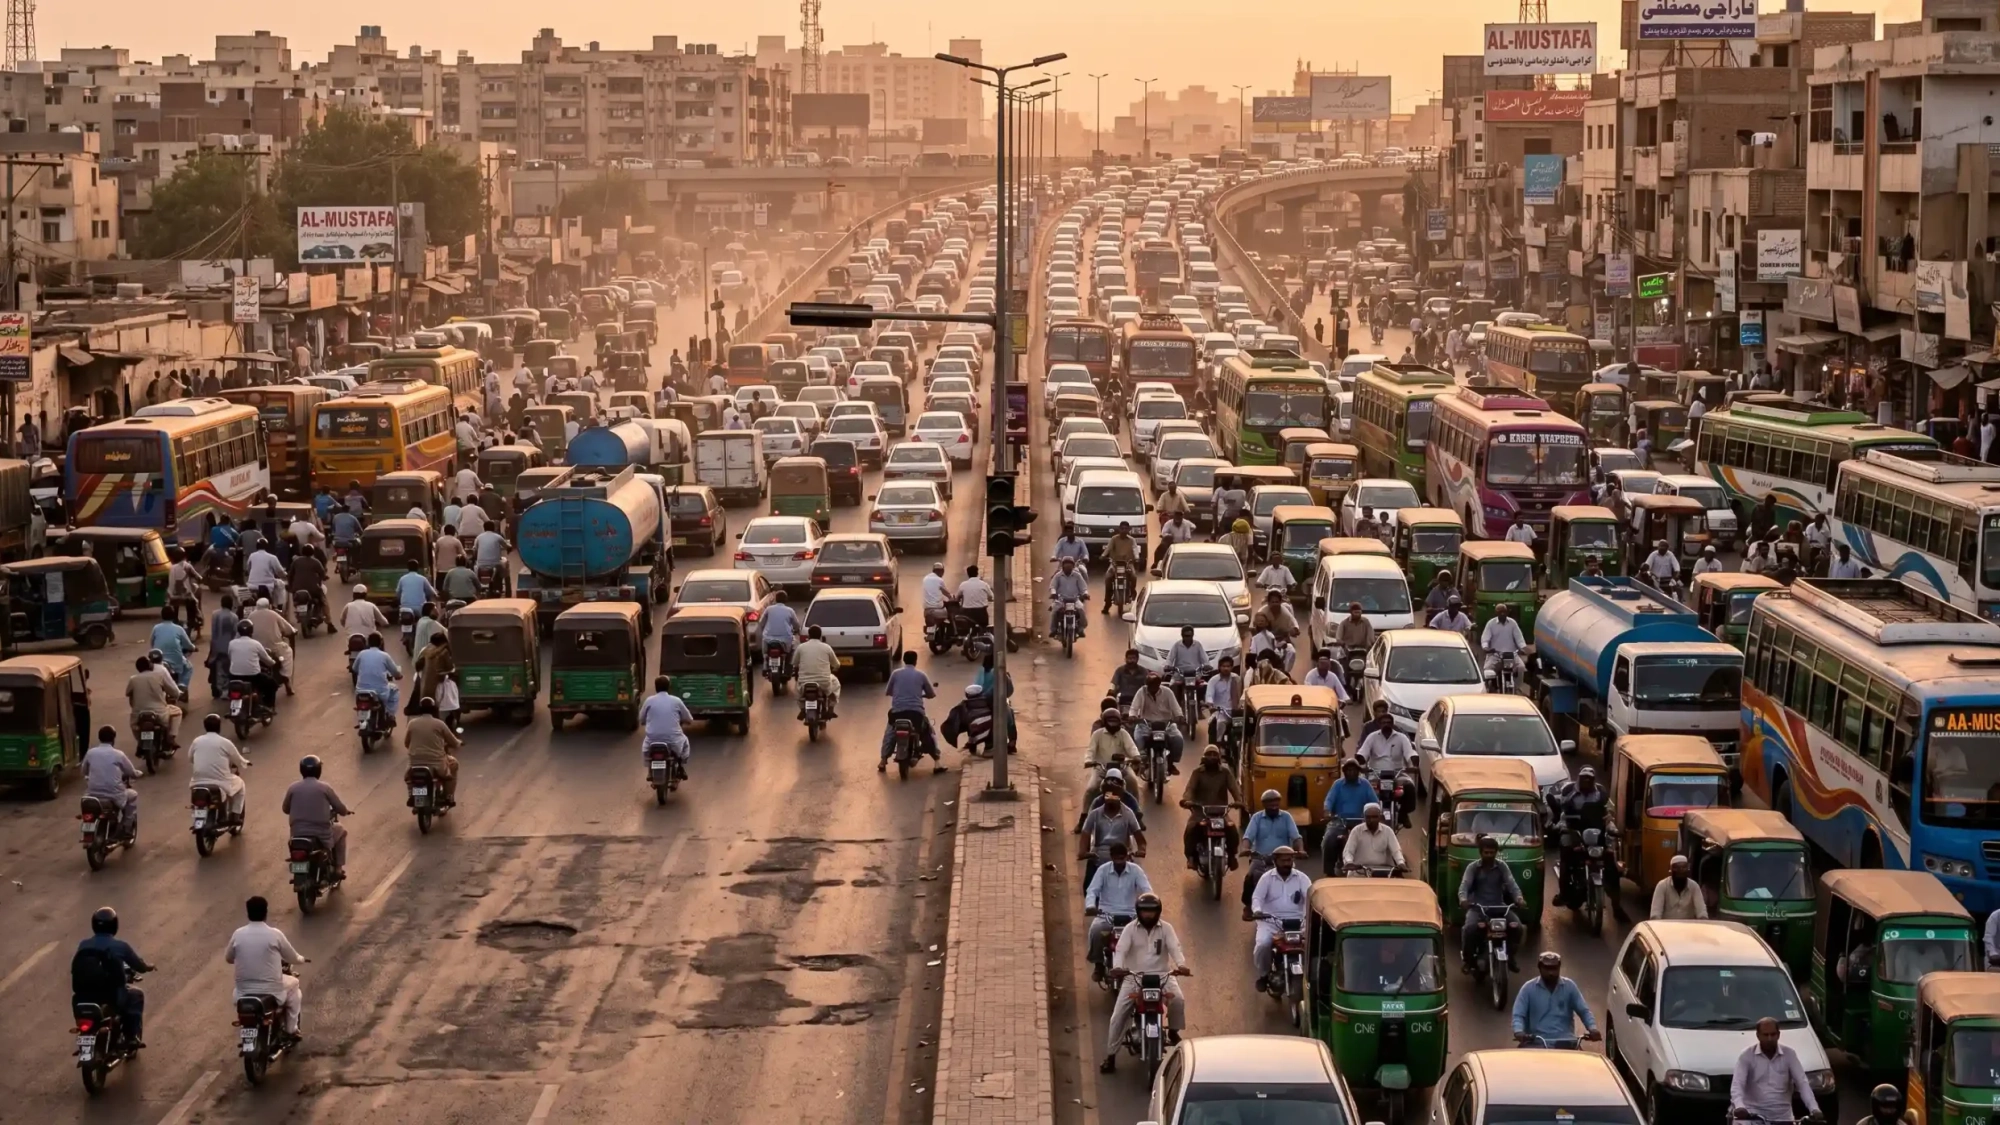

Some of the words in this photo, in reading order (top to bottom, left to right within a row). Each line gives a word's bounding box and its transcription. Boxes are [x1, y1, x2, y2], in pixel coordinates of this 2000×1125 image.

[1487, 29, 1592, 50] AL-MUSTAFA
[300, 211, 395, 228] AL-MUSTAFA
[1947, 712, 2000, 730] AA-MUS
[1411, 1021, 1433, 1034] CNG
